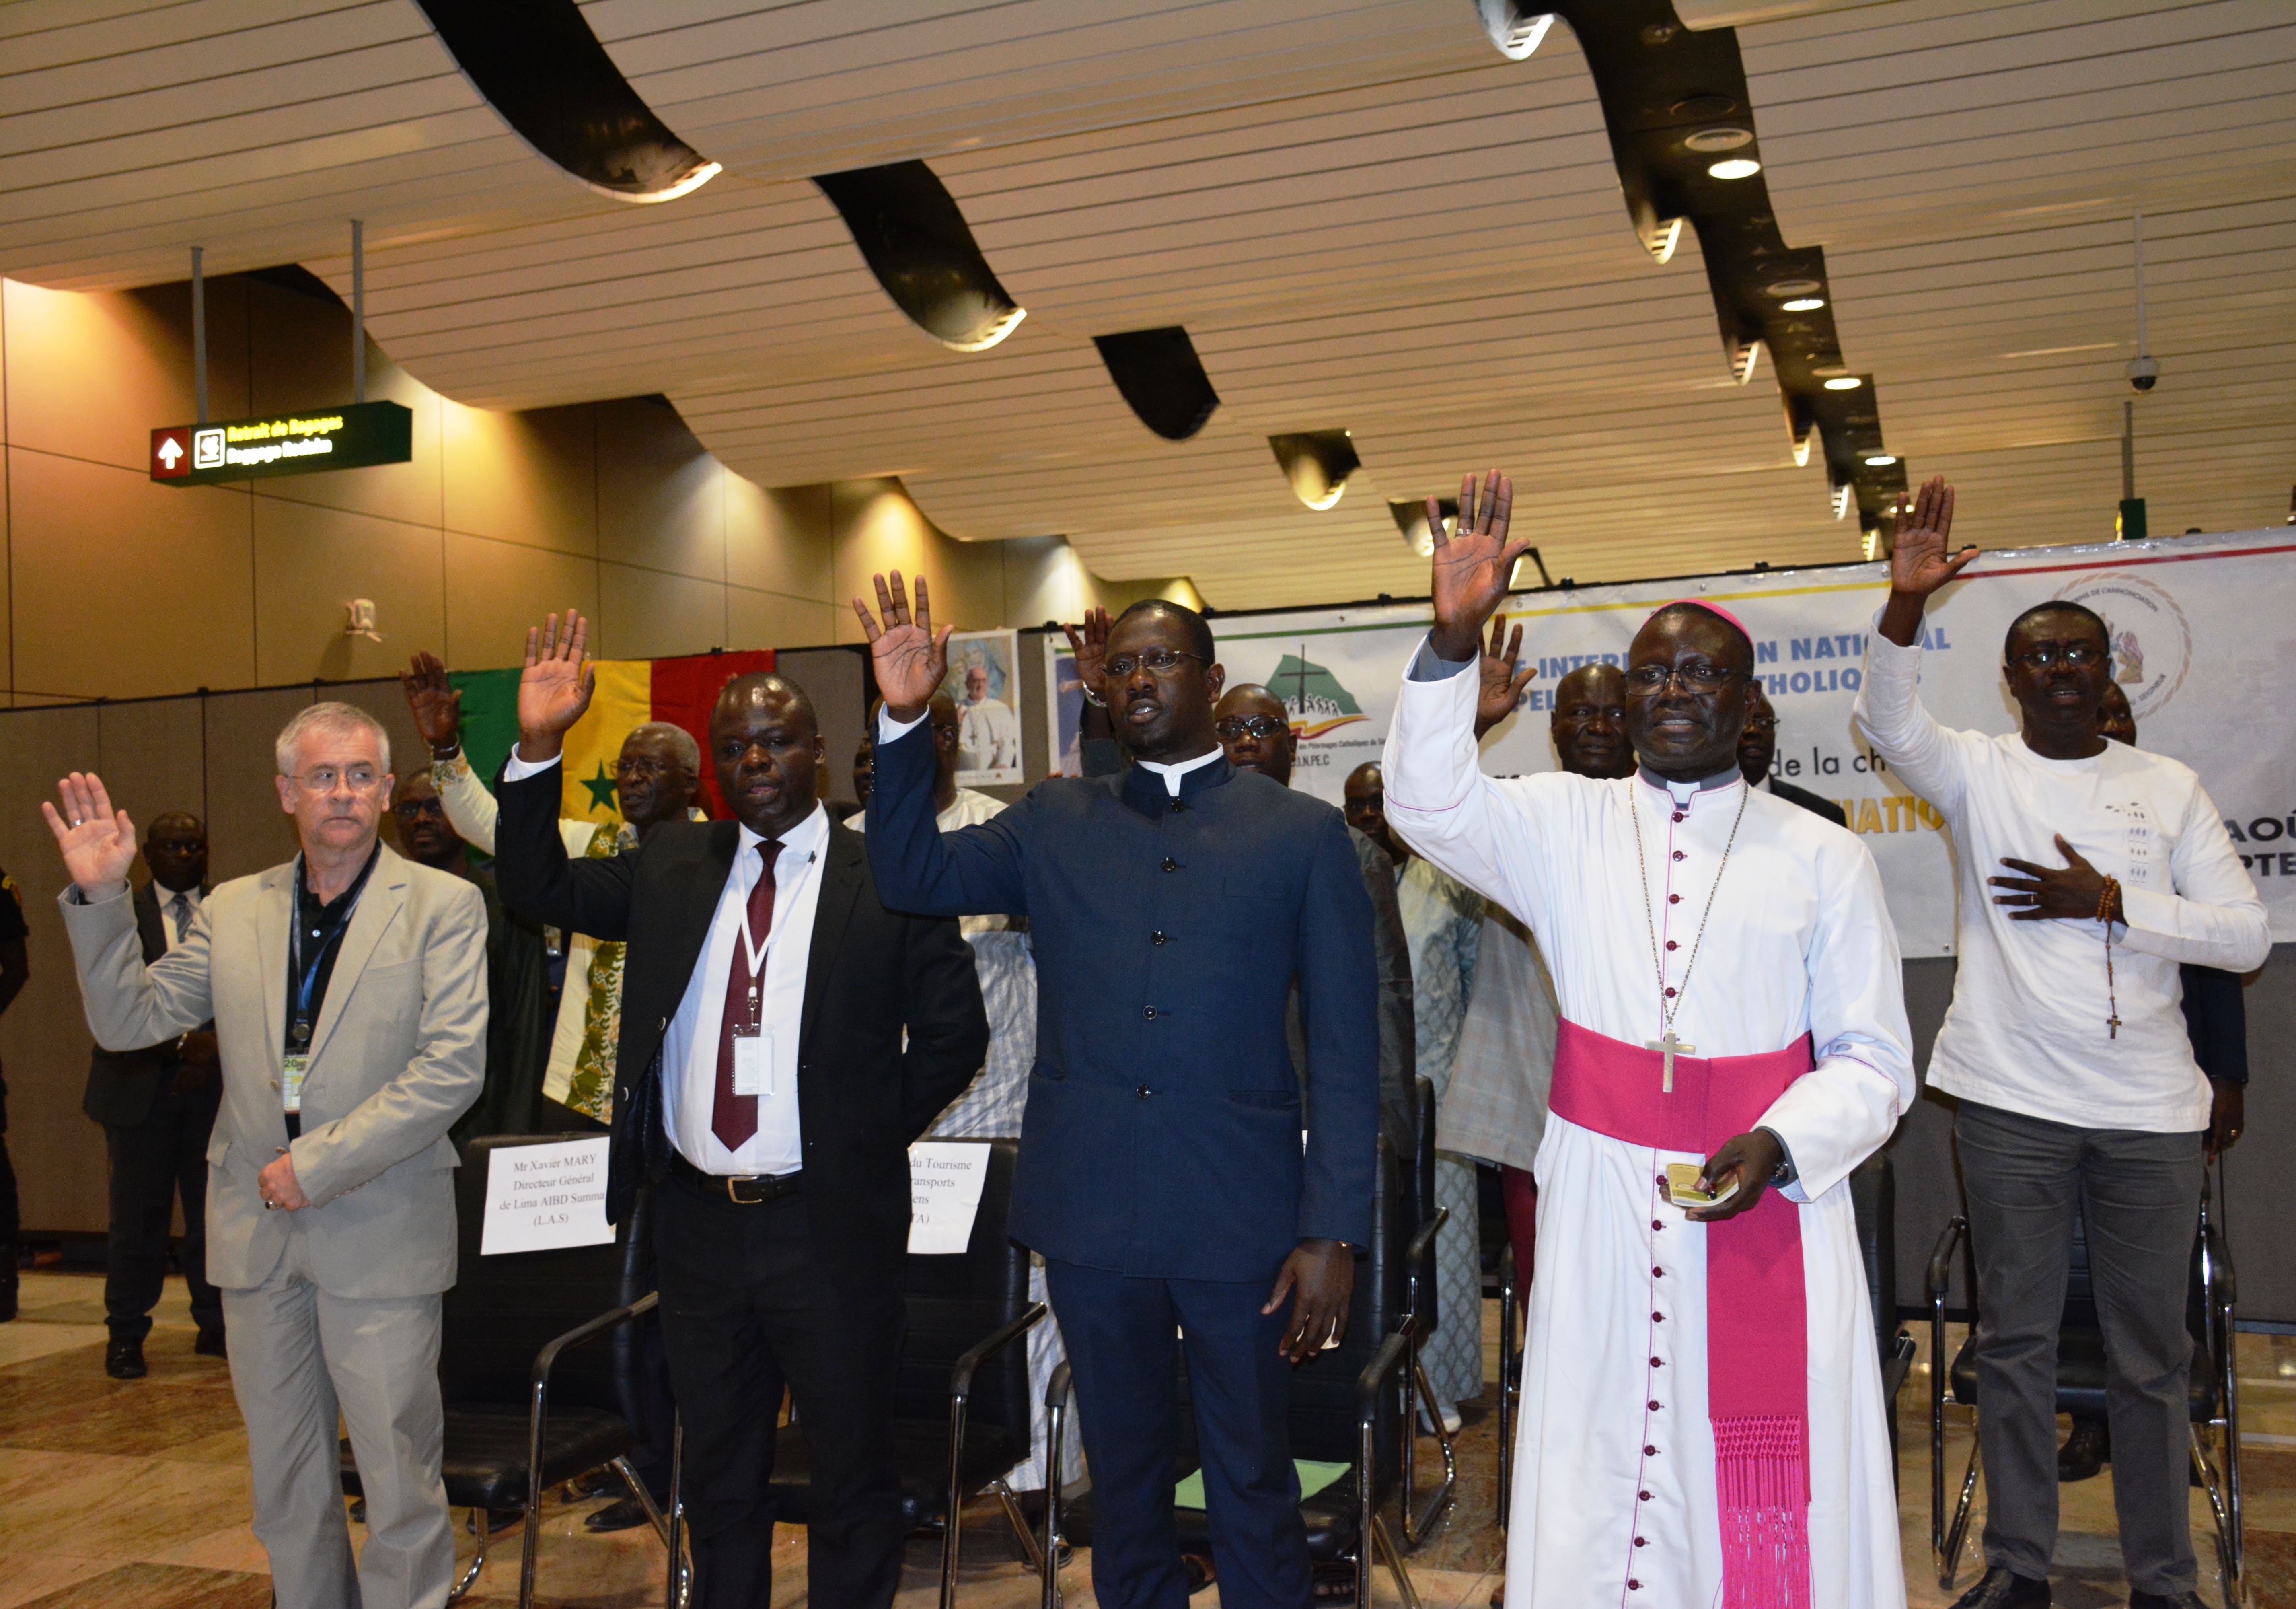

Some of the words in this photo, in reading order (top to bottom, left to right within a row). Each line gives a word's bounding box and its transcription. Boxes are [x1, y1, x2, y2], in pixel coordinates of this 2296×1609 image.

[227, 422, 270, 442] Retrait
[270, 421, 288, 437] de
[289, 416, 343, 436] Bagages
[1791, 628, 1951, 661] NATIAL
[1769, 749, 1800, 777] de
[1813, 746, 1840, 775] la
[1853, 746, 1885, 773] ch
[514, 1162, 528, 1172] Mr
[530, 1160, 561, 1171] Xavier
[564, 1154, 597, 1167] MARY
[926, 1158, 972, 1170] Tourisme
[514, 1179, 556, 1190] Directeur
[559, 1173, 594, 1186] Général
[499, 1200, 511, 1210] de
[514, 1199, 538, 1209] Lima
[541, 1194, 568, 1206] AIBD
[571, 1193, 604, 1203] Summa
[913, 1196, 929, 1204] ens
